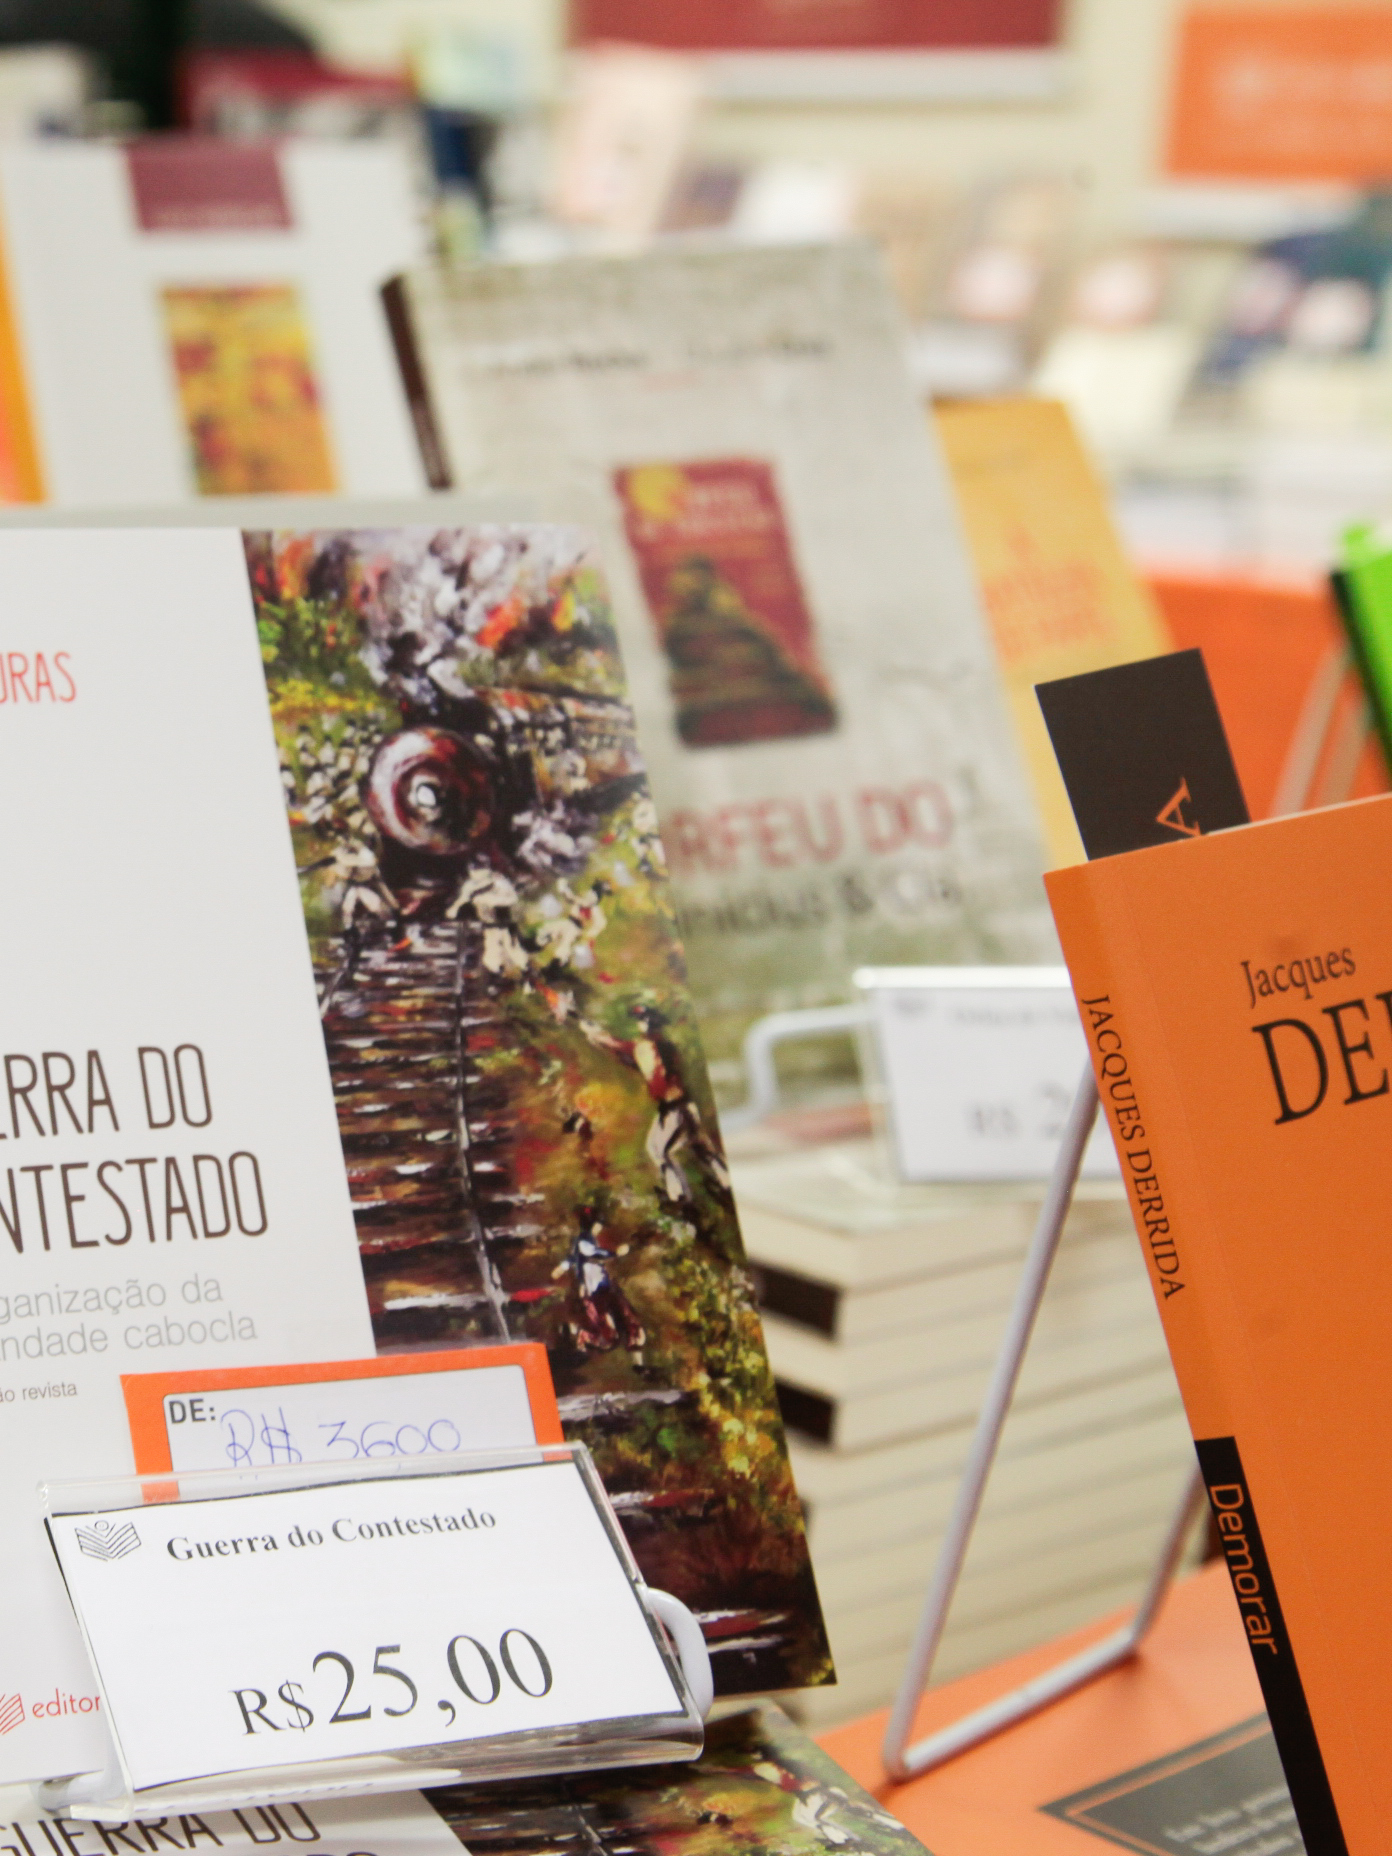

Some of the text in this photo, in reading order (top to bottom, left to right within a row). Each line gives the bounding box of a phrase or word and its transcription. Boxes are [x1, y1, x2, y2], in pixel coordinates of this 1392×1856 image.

[664, 788, 846, 875] RFEU
[1241, 947, 1356, 1009] Jacques
[1252, 989, 1392, 1125] DE
[138, 1043, 214, 1130] DO
[1082, 995, 1186, 1300] JACQUES DERRIDA
[181, 1273, 224, 1303] da
[124, 1311, 258, 1350] cabocla
[22, 1382, 78, 1403] revista
[168, 1398, 216, 1424] DE:
[166, 1507, 497, 1561] Guerra do Contestado
[1210, 1483, 1277, 1656] Demorar
[32, 1688, 101, 1720] editor
